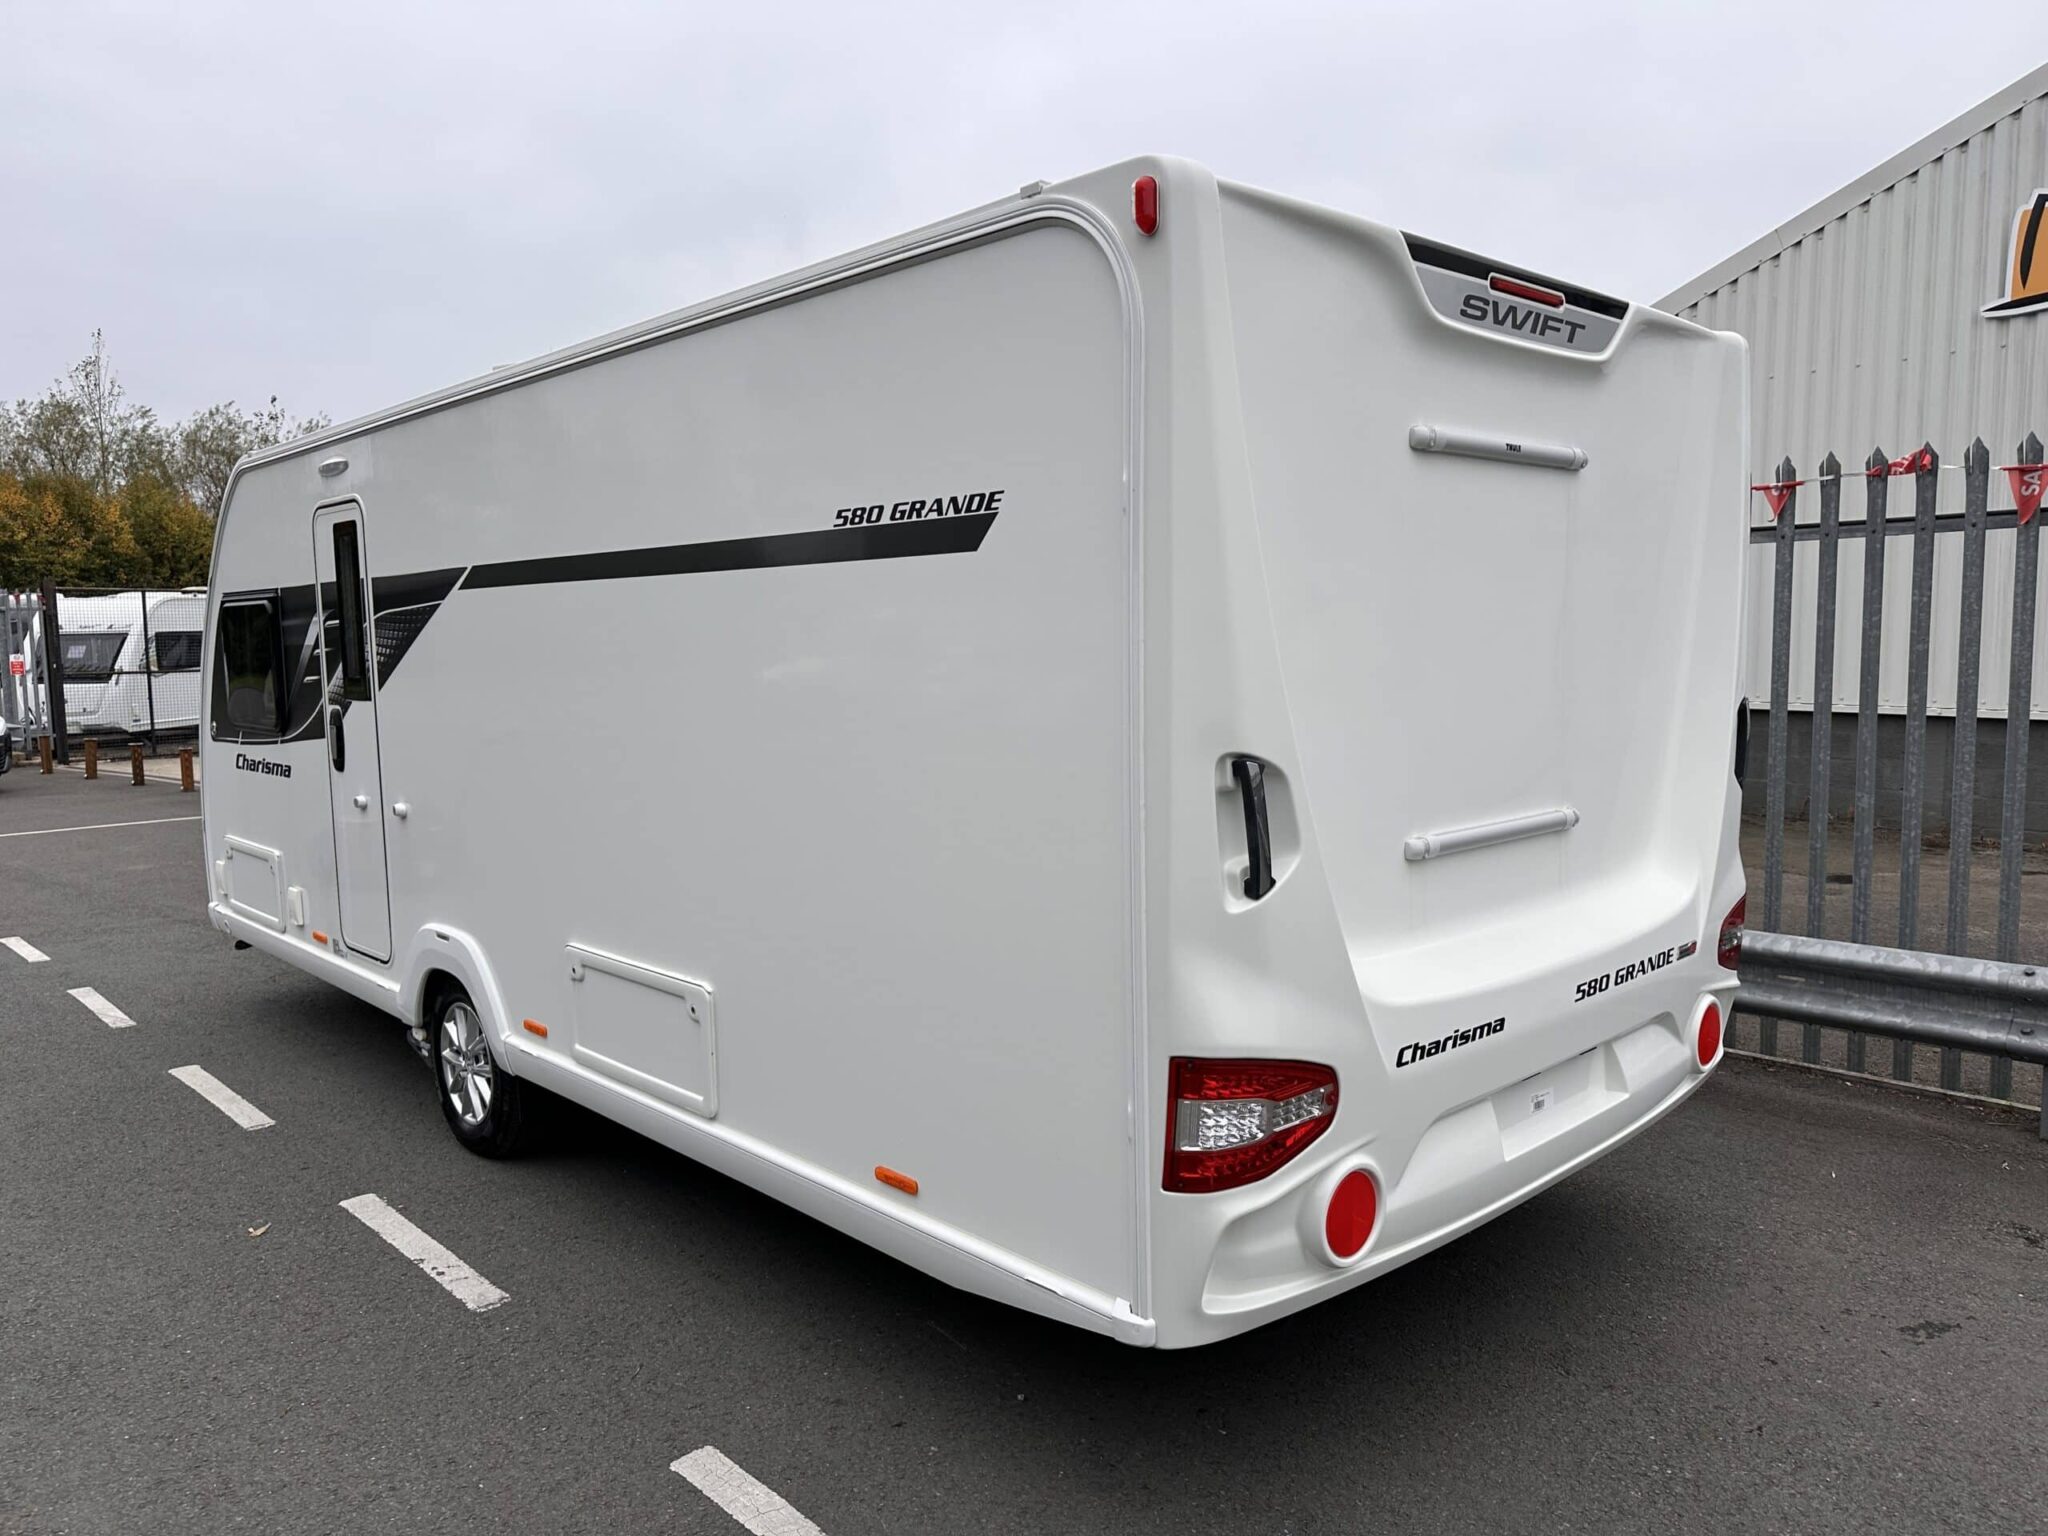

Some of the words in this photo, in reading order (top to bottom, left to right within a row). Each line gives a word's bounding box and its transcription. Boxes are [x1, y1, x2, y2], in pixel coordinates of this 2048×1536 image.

[1459, 294, 1586, 344] SWIFT
[833, 504, 885, 528] 580
[889, 490, 1005, 522] GRANDE
[235, 752, 292, 779] Charisma
[1574, 973, 1611, 1003] 580
[1613, 947, 1675, 987] GRANDE
[1395, 1017, 1506, 1069] Charisma
